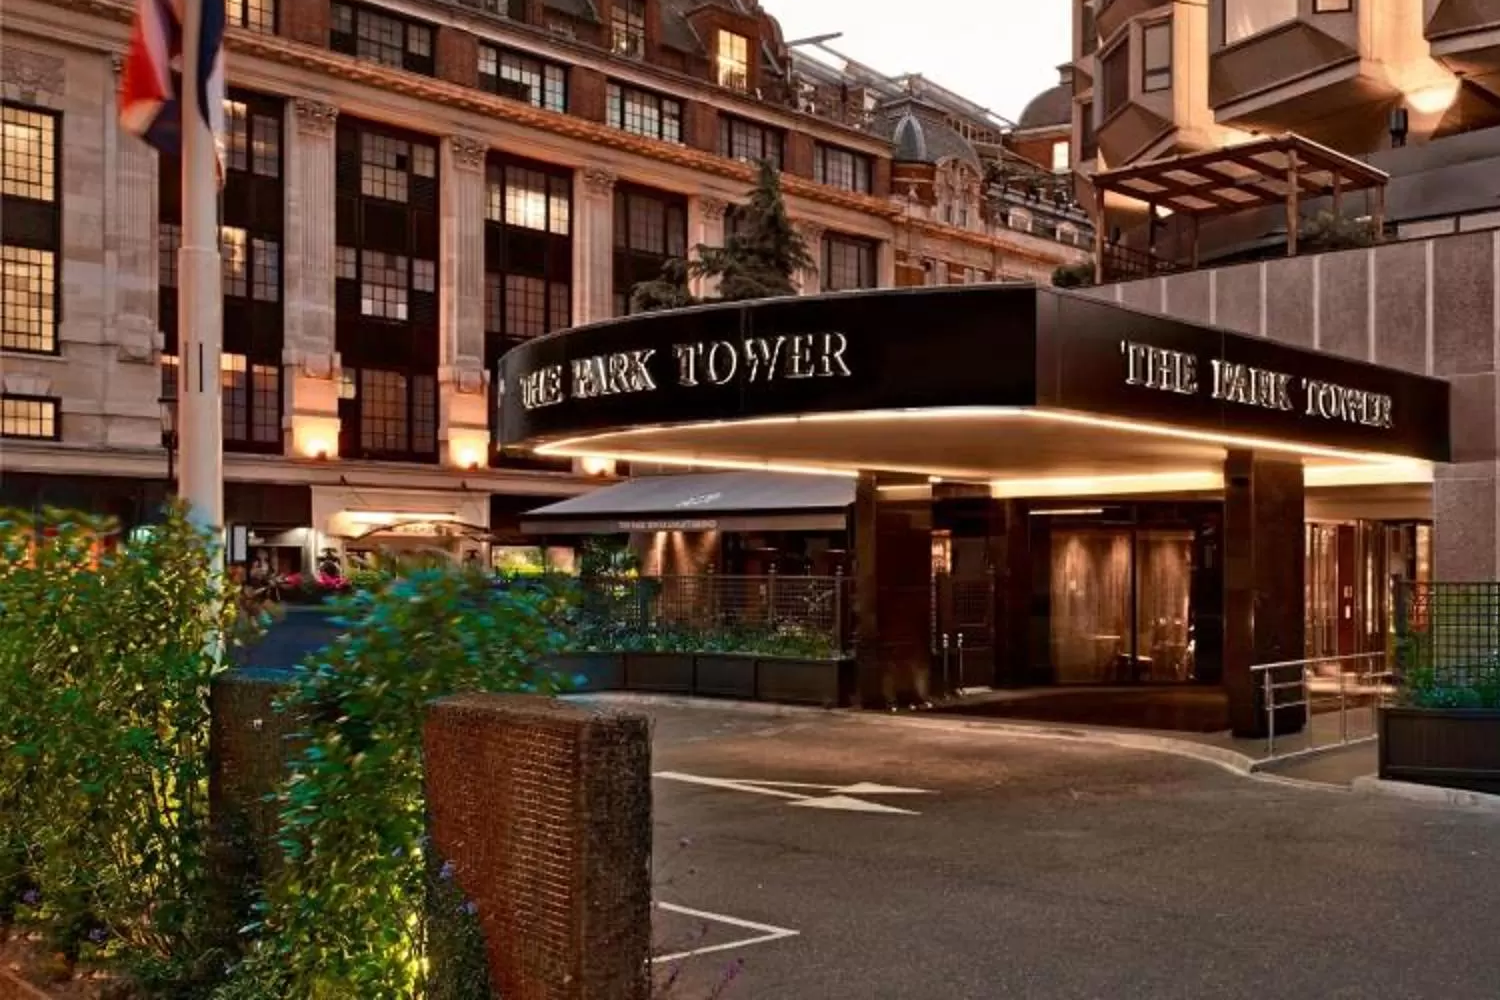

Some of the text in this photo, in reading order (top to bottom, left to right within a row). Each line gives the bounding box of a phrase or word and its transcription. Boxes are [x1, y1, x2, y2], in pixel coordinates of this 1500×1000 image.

[519, 331, 852, 409] THE PARK TOWER
[1120, 340, 1393, 429] THE PARK TOWER
